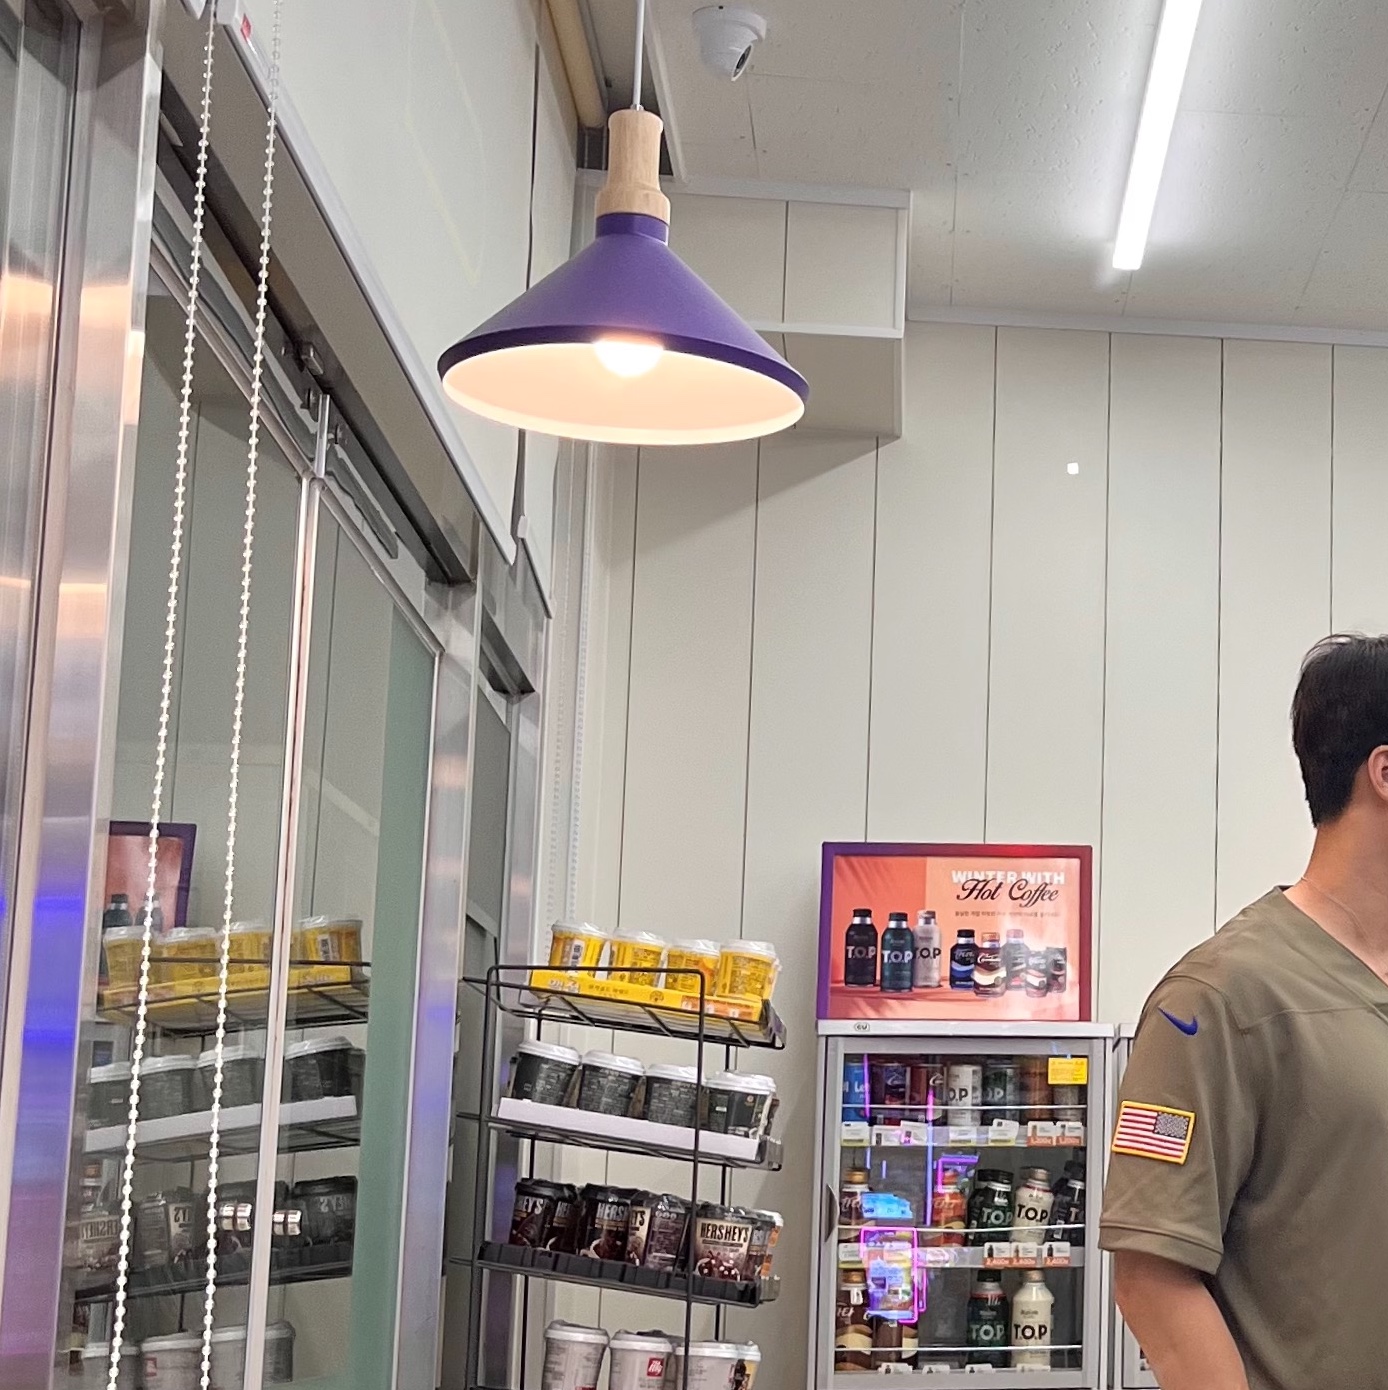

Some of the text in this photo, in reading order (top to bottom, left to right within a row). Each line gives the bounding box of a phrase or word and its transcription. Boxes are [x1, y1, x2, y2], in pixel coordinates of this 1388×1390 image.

[952, 870, 1065, 885] WINTER WITH
[957, 878, 1060, 908] Hot Coffee
[882, 950, 914, 964] T.O.P
[1017, 1204, 1048, 1222] T.O.P
[1014, 1323, 1048, 1340] T.O.P
